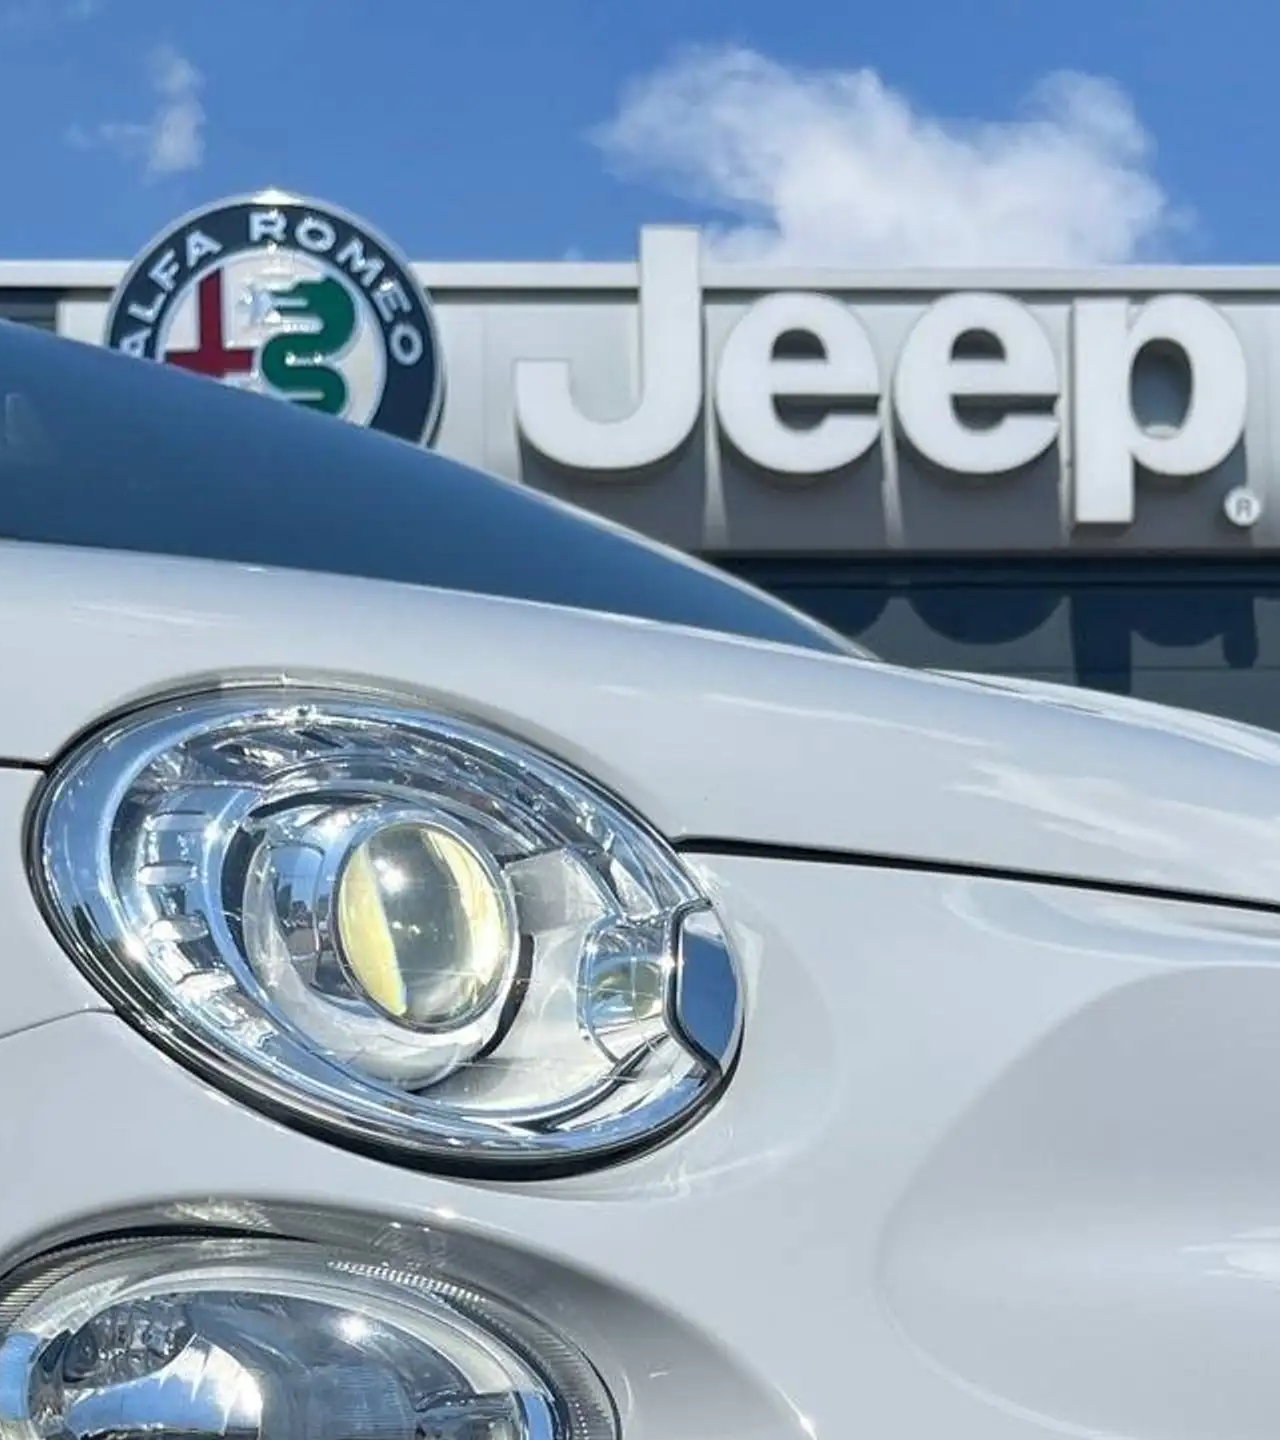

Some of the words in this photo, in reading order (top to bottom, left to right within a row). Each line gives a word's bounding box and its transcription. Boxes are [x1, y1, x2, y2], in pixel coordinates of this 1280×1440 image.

[120, 229, 223, 357] ALFA
[249, 207, 424, 366] ROMEO
[514, 224, 1249, 525] Jeep
